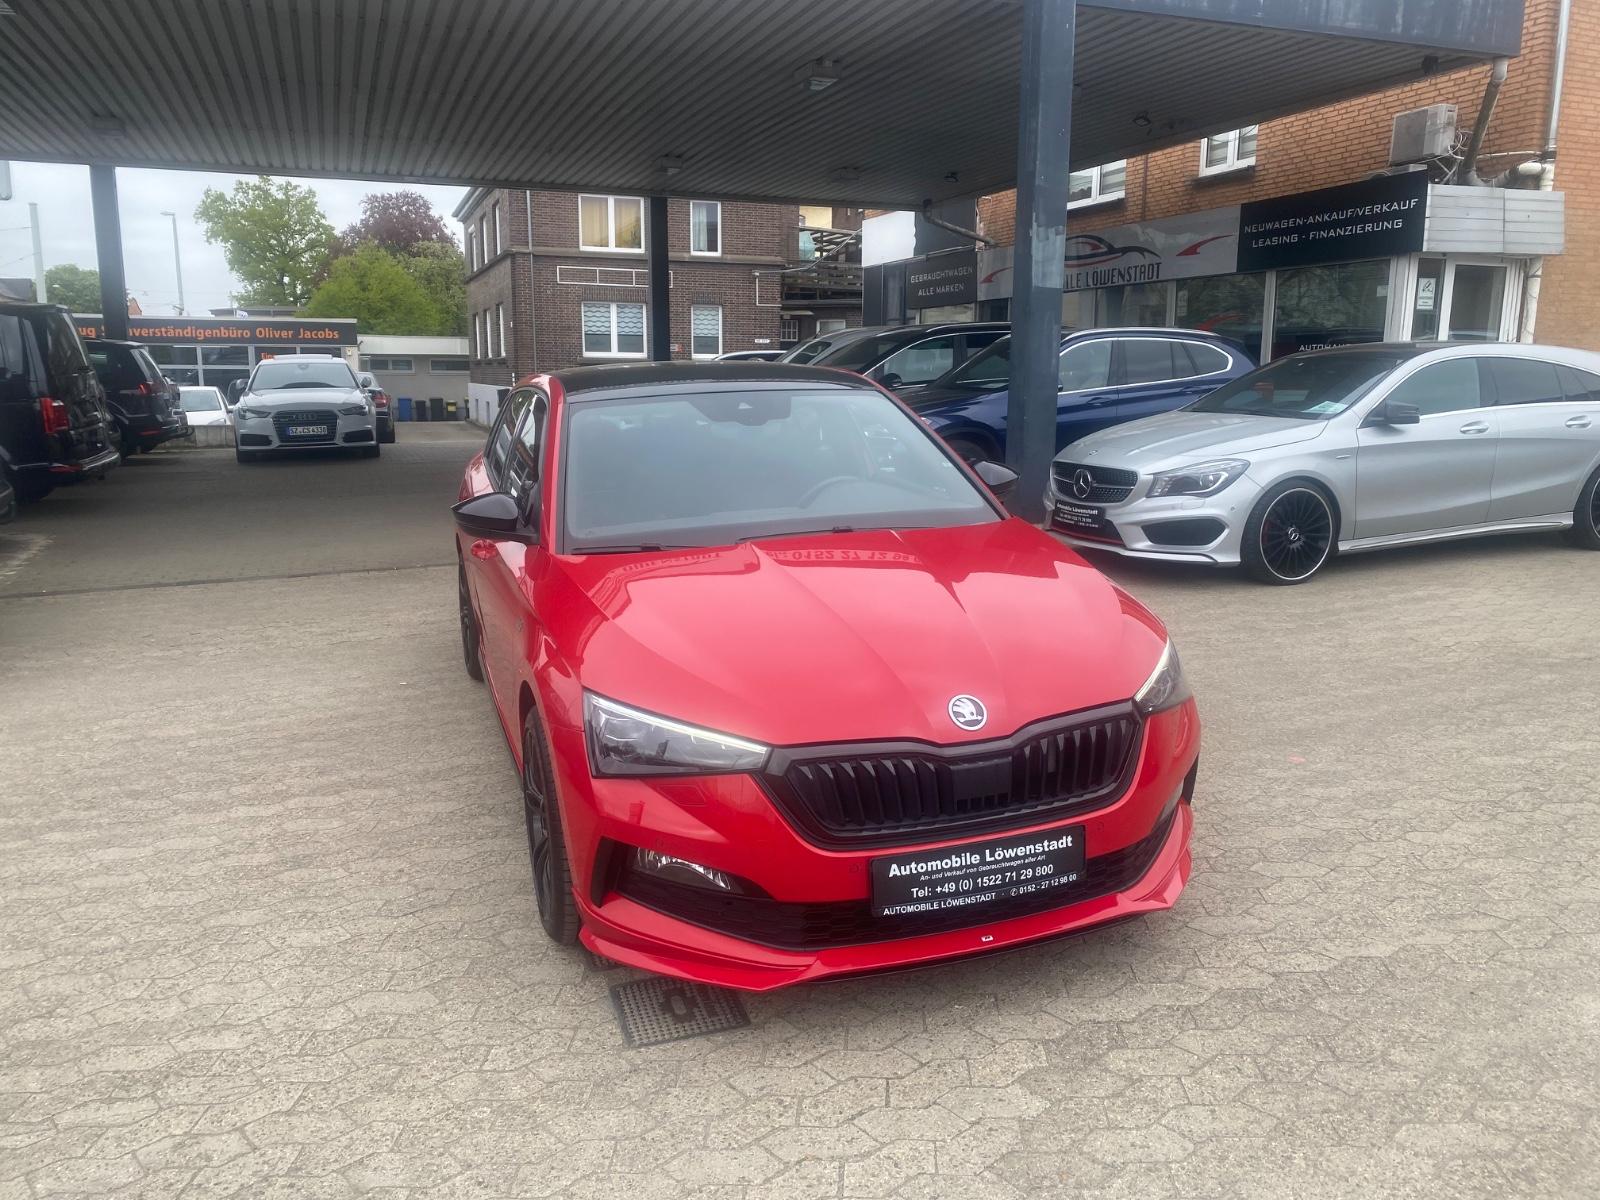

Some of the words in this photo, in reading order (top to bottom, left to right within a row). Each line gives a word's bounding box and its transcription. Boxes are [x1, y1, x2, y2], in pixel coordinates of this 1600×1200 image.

[1244, 198, 1419, 233] NEUWAGEN-ANKAUF/VERKAUF
[1252, 234, 1298, 248] LEASING
[1309, 219, 1403, 240] FINANZIERUNG
[911, 265, 973, 283] GEBRAUCHTWAGEN
[1086, 262, 1162, 288] LÖWENSTADT
[918, 287, 935, 296] ALLE
[936, 282, 965, 294] MARKEN
[255, 327, 294, 339] Oliver
[298, 328, 340, 339] Jacobs
[888, 852, 980, 878] Automobile
[985, 835, 1073, 862] Löwenstadt
[911, 886, 932, 898] Tel:
[935, 882, 956, 894] +49
[959, 878, 973, 892] (0)
[976, 873, 1002, 887] 1522
[1005, 871, 1017, 882] 71
[1020, 868, 1033, 880] 29
[1035, 864, 1054, 876] 800
[920, 874, 930, 882] An-
[932, 872, 943, 880] und
[944, 868, 966, 877] Verkauf
[978, 859, 1024, 872] Gebrauchtwagen
[883, 901, 940, 915] AUTOMOBILE
[941, 892, 996, 908] LÖWENSTADT
[1019, 884, 1036, 894] 0152
[1041, 881, 1050, 889] 27
[1051, 878, 1059, 886] 12
[1069, 873, 1077, 882] 00
